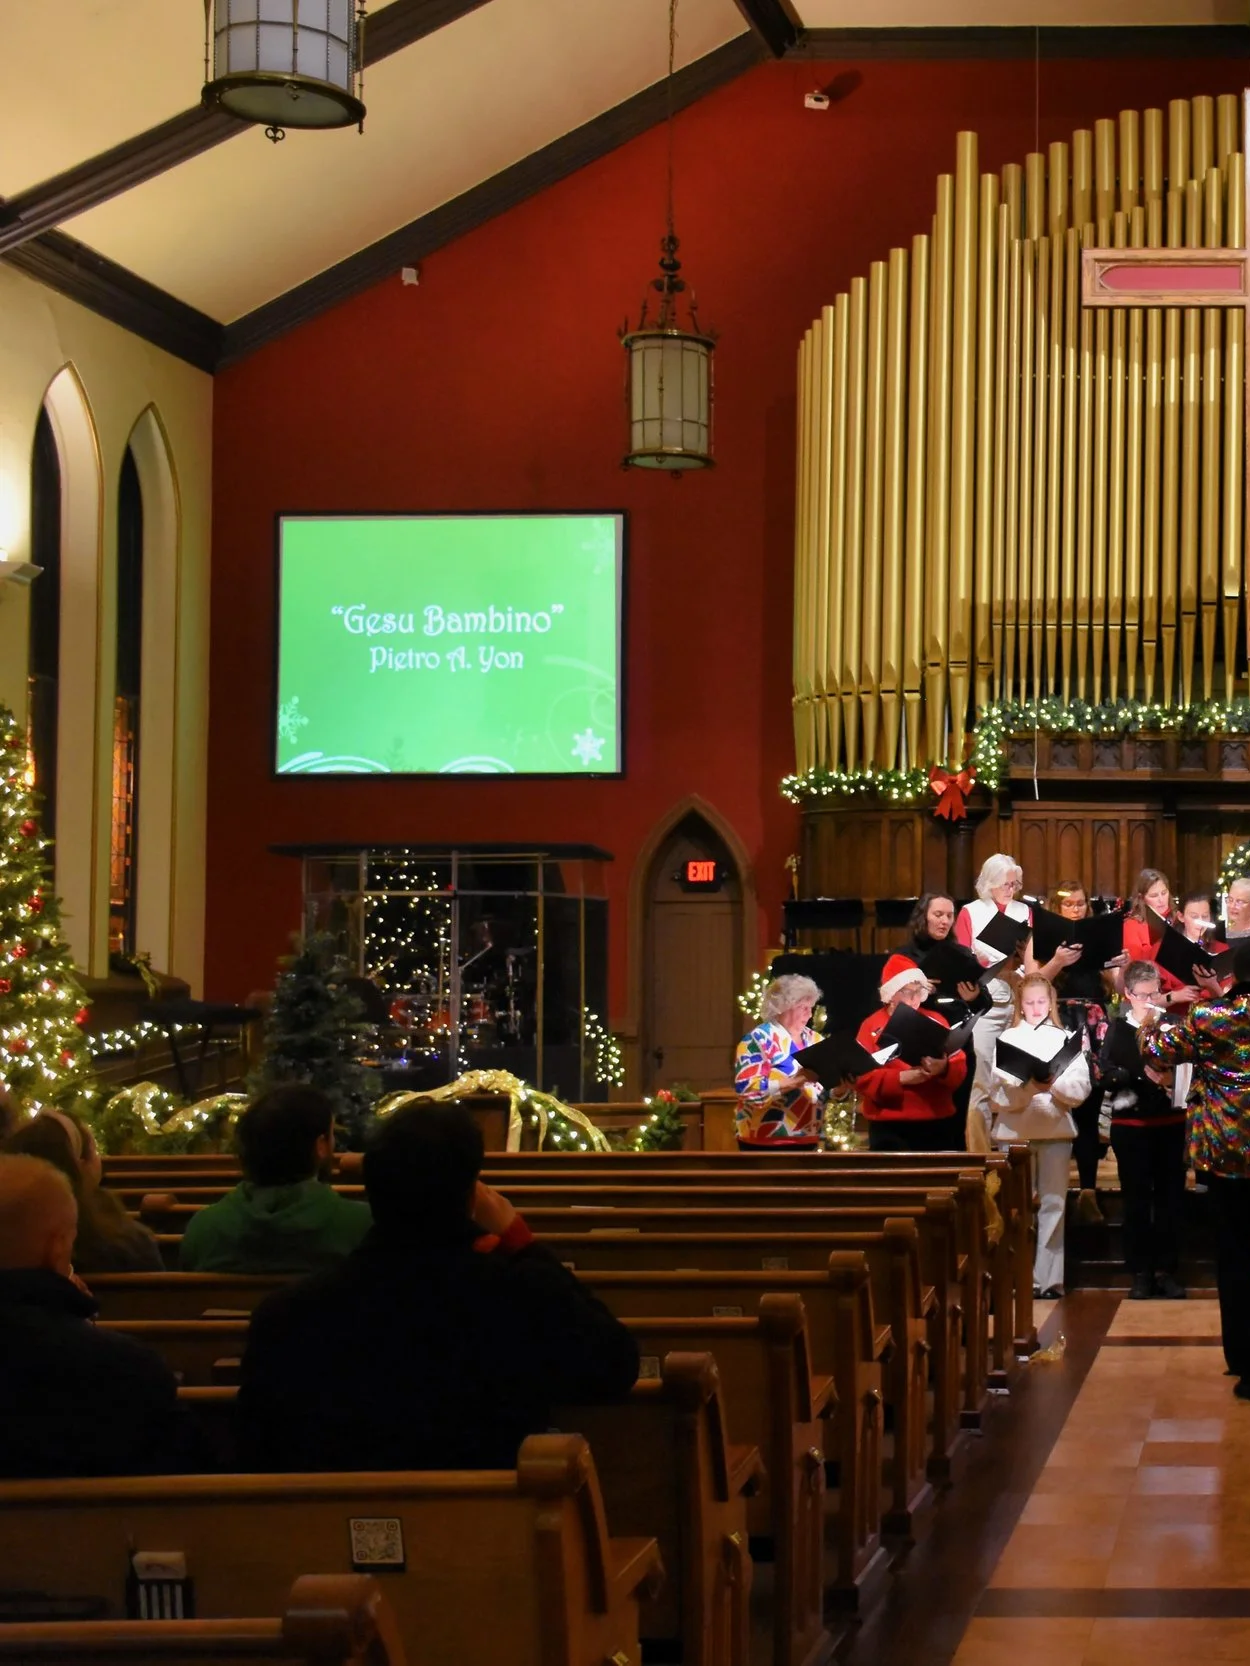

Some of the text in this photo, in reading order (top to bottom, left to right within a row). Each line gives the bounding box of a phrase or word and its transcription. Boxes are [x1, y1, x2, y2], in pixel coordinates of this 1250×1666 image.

[331, 604, 564, 637] “Gesu Bambino”
[369, 646, 524, 673] Pietro A. Yon
[687, 861, 716, 882] EXIT
